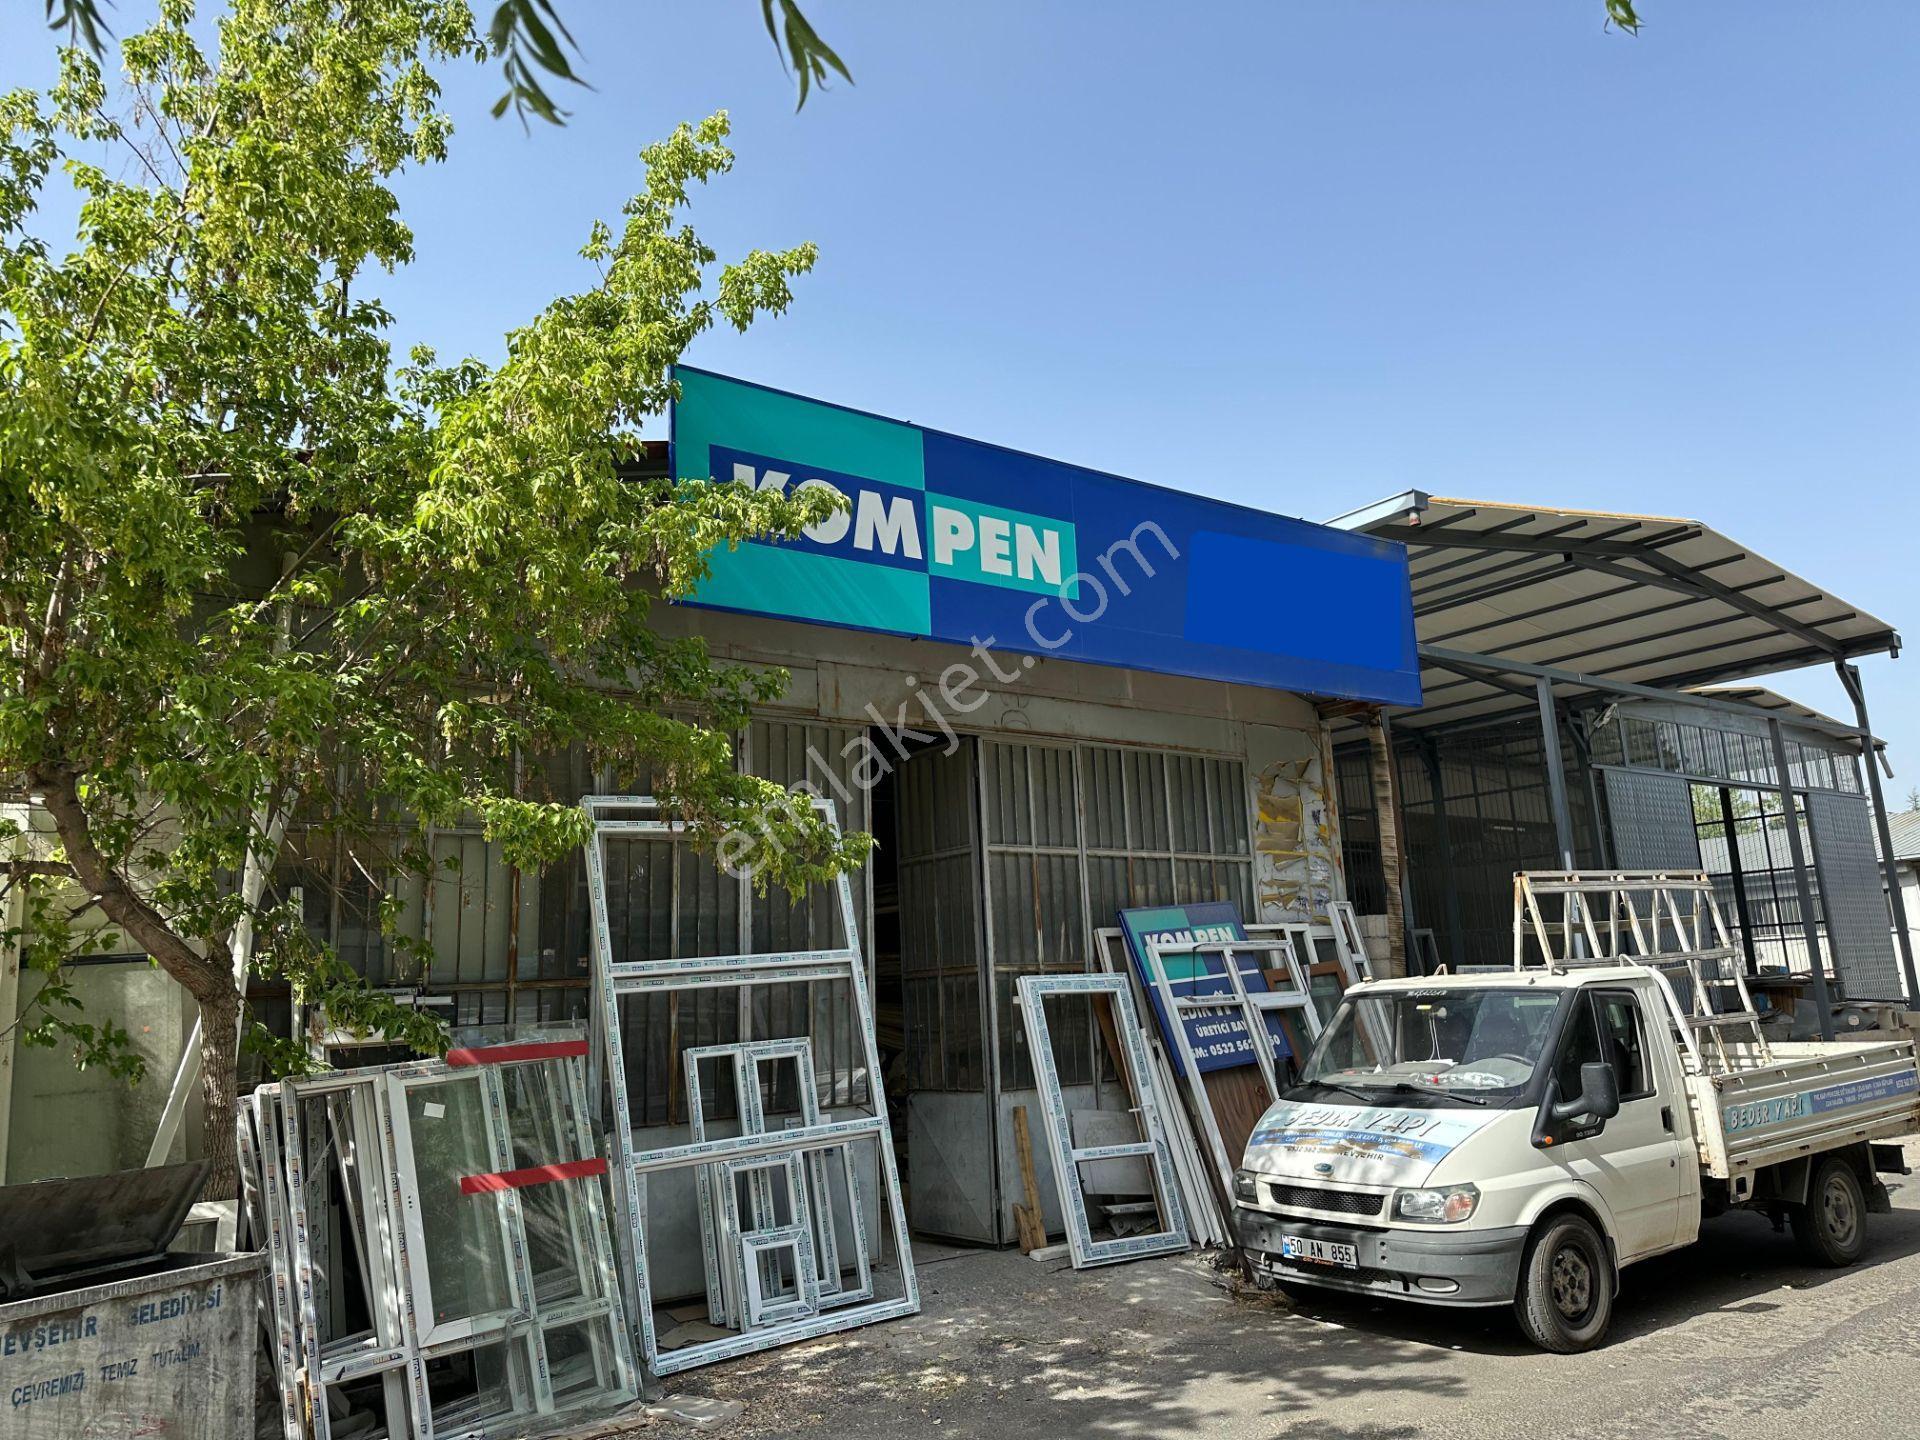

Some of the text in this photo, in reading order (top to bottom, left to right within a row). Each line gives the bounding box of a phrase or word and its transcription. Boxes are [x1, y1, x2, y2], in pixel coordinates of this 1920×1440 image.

[1195, 1020, 1231, 1038] ÜRETİCİ
[1209, 1042, 1236, 1057] 0532
[1290, 1239, 1303, 1254] 50
[1310, 1242, 1323, 1258] AN
[1330, 1245, 1352, 1262] 855
